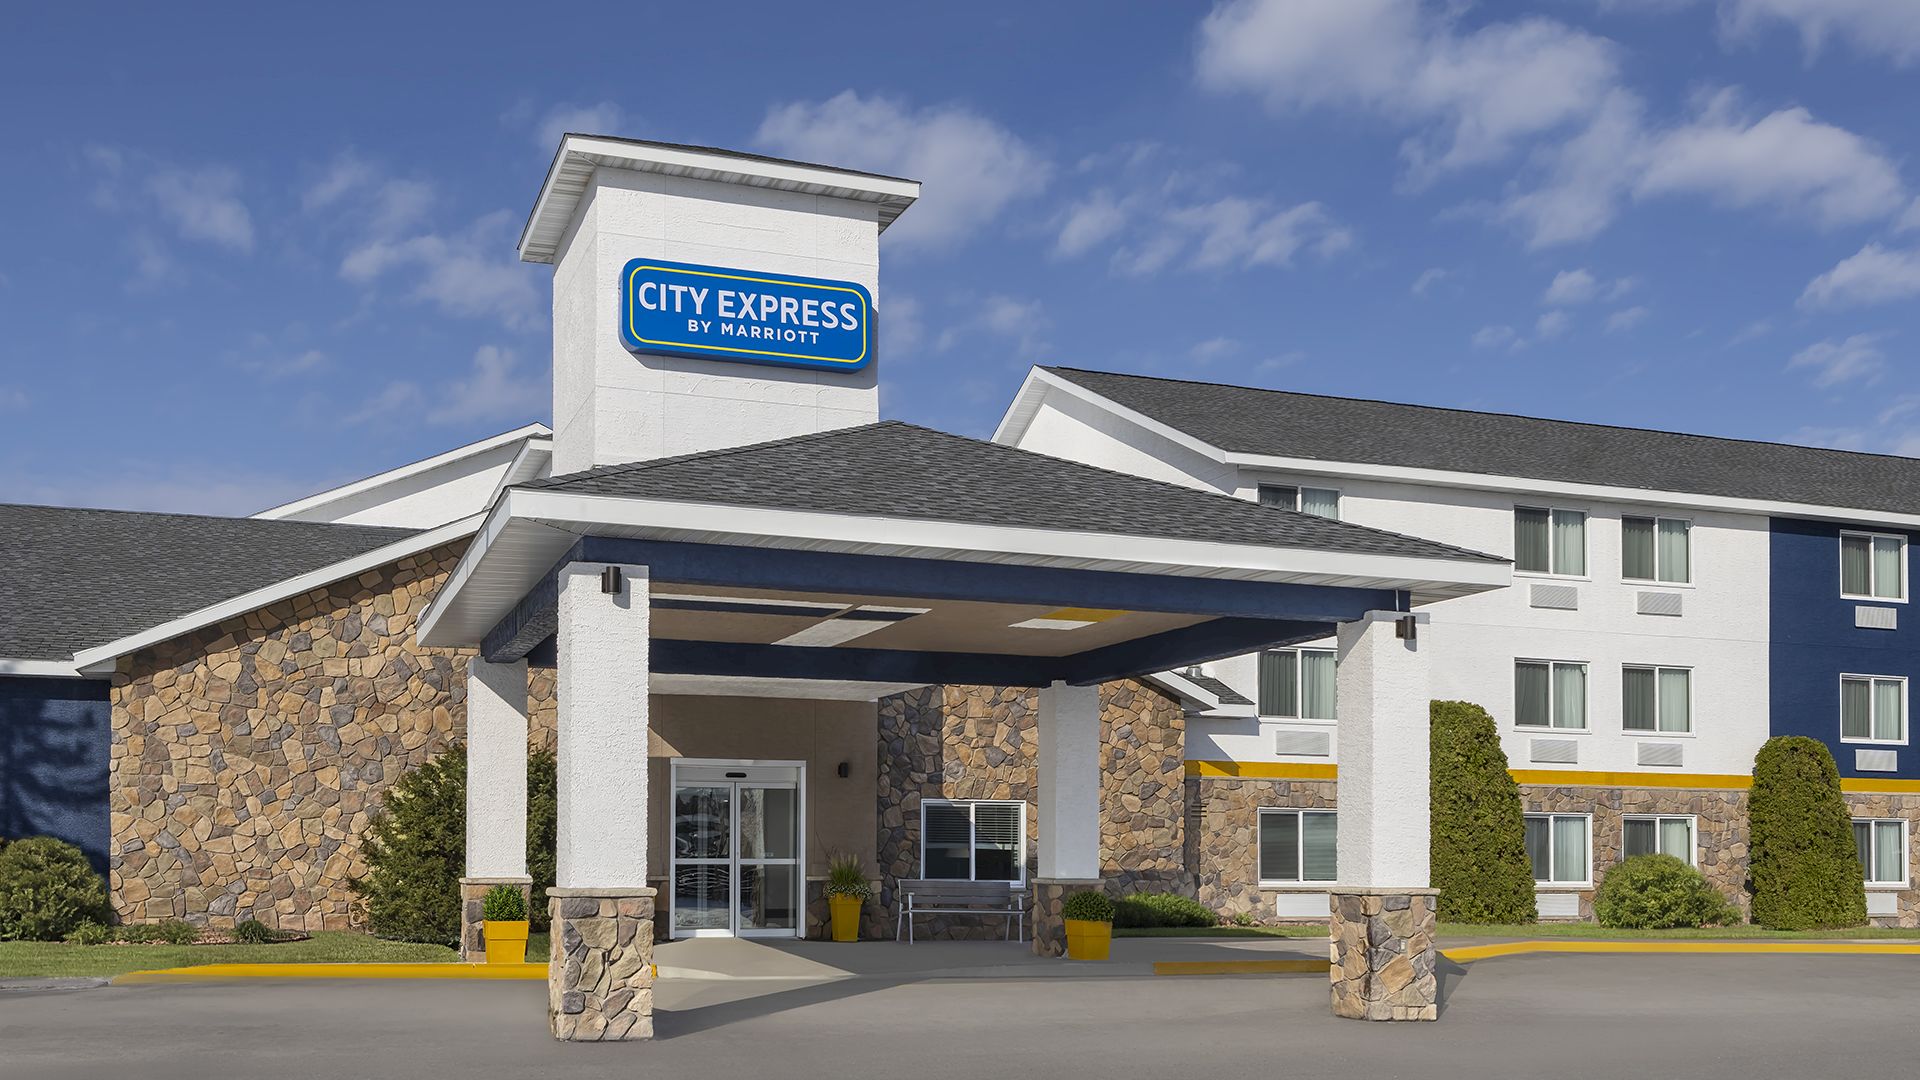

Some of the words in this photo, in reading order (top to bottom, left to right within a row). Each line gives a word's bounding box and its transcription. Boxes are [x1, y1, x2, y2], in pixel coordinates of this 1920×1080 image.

[638, 281, 709, 315] CITY
[718, 289, 859, 332] EXPRESS
[688, 319, 712, 333] BY
[721, 322, 820, 345] MARRIOTT
